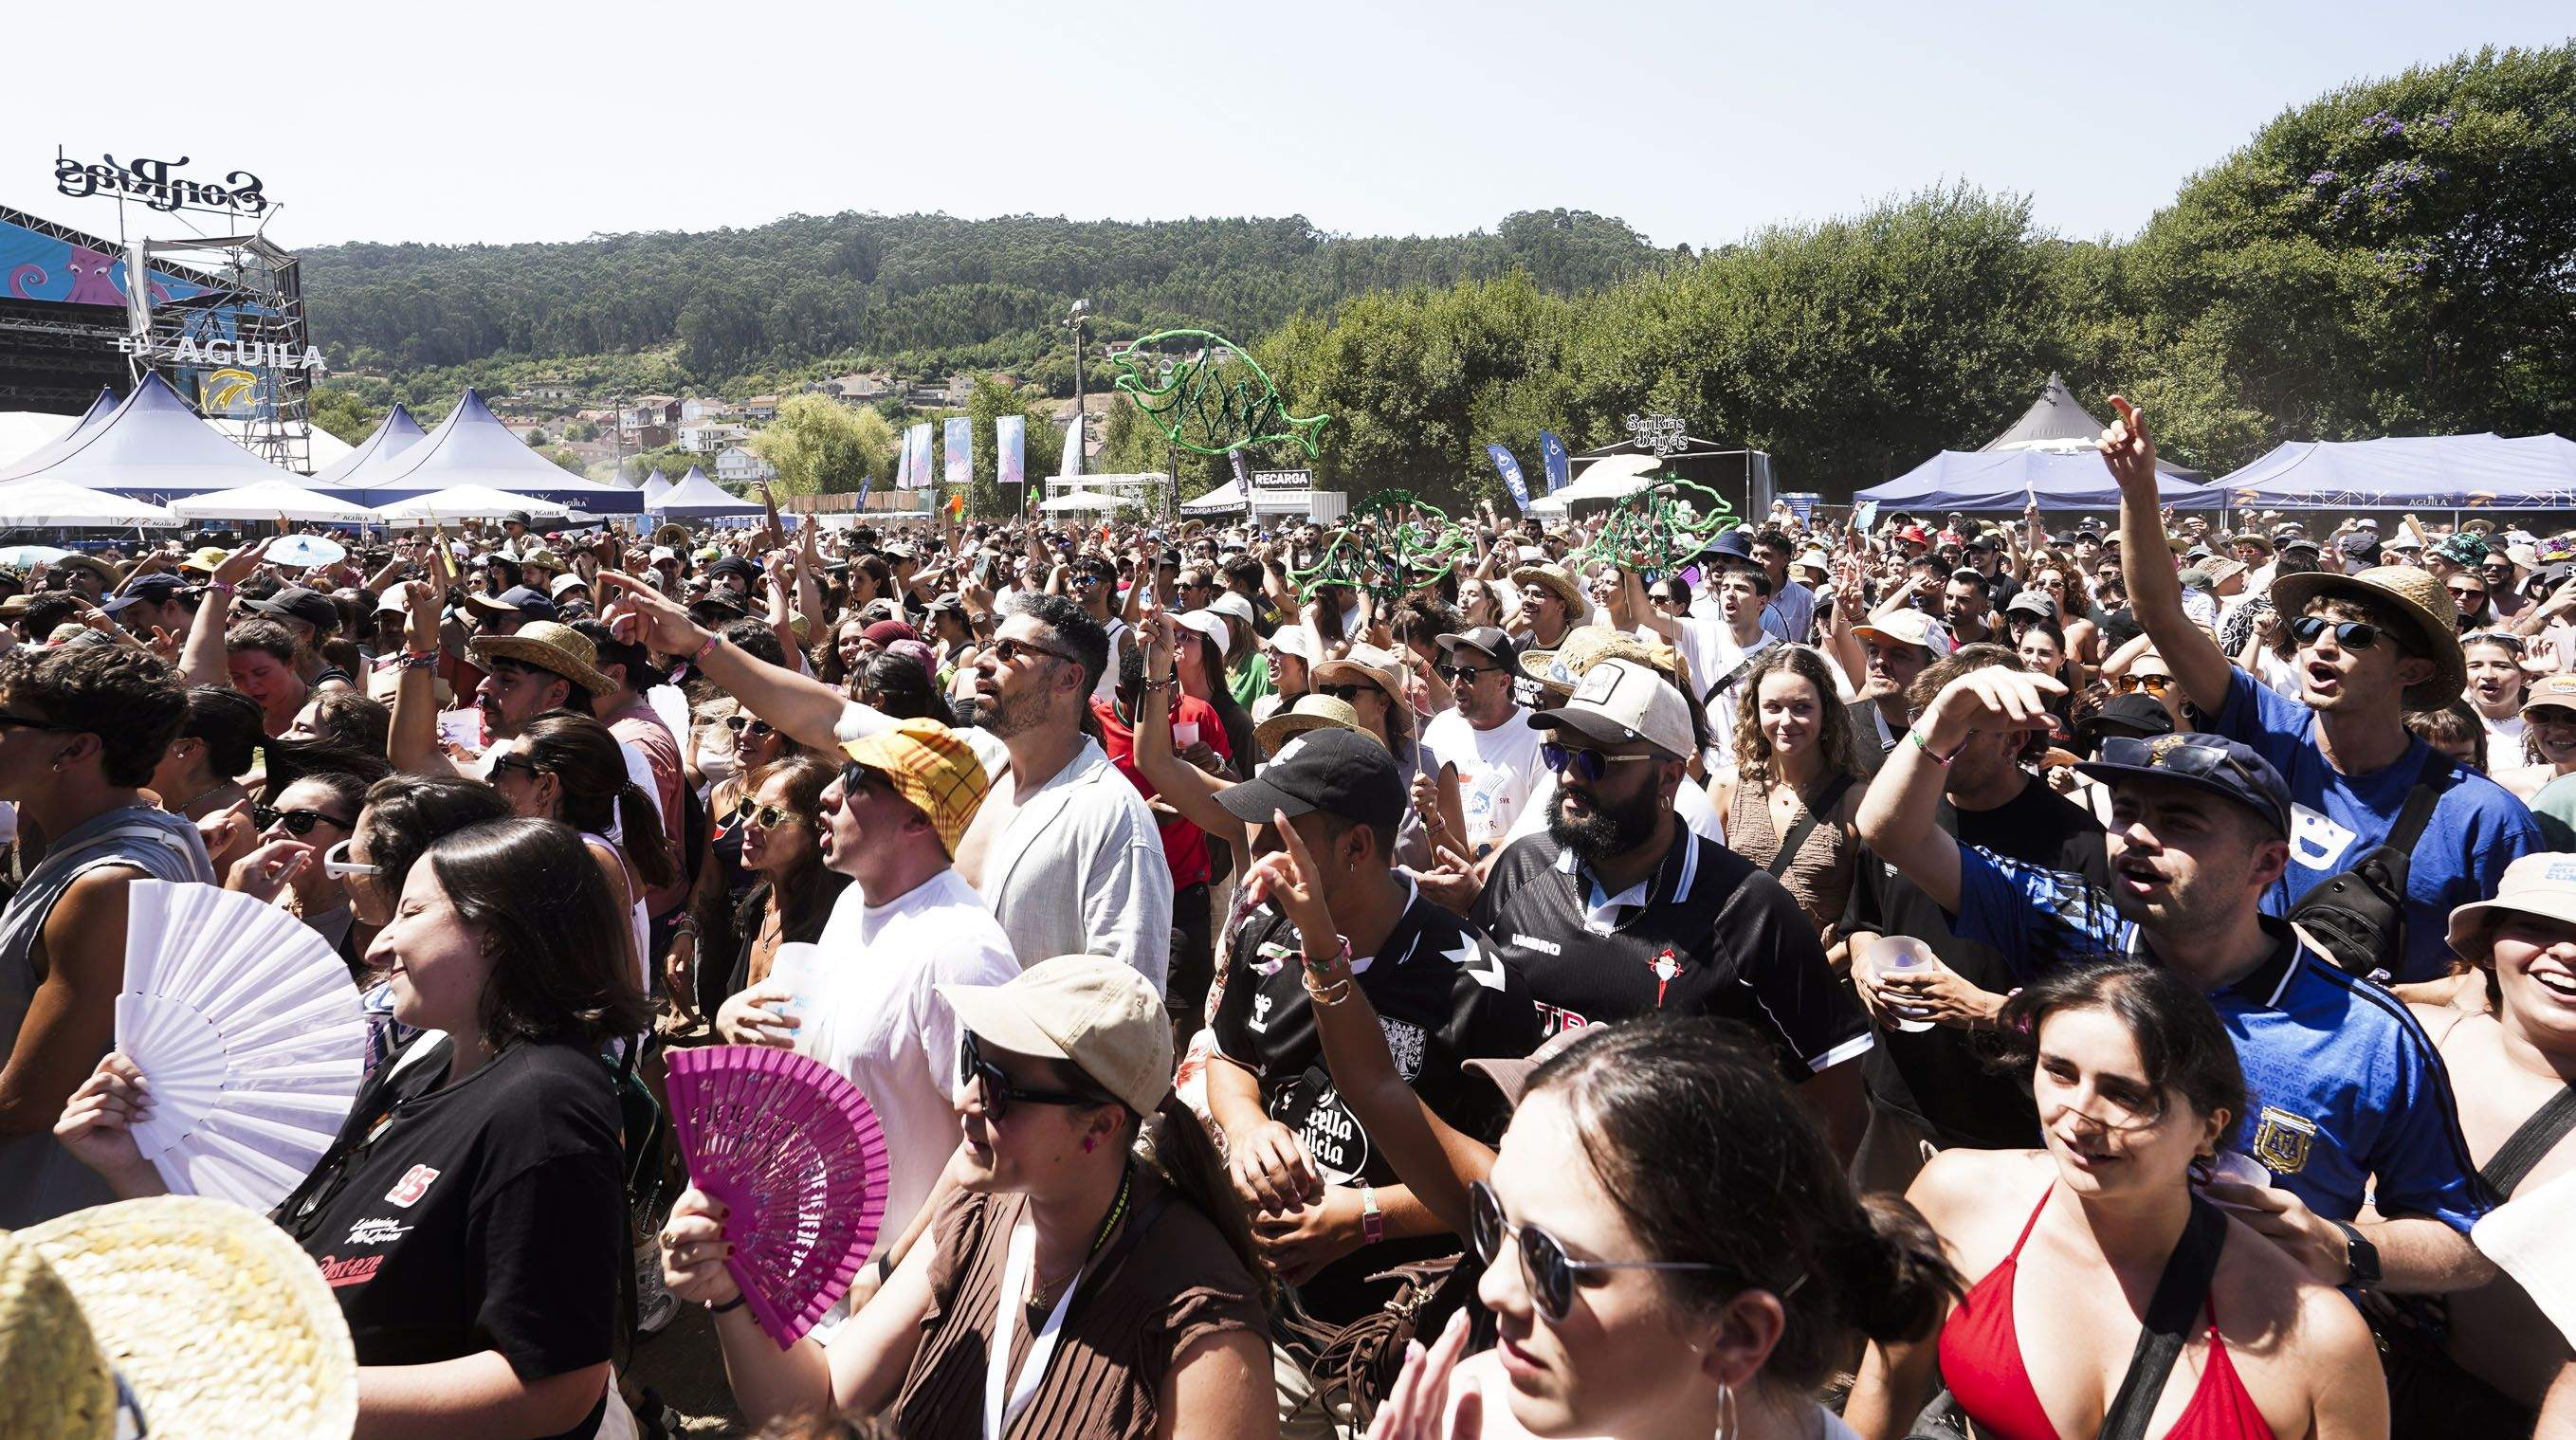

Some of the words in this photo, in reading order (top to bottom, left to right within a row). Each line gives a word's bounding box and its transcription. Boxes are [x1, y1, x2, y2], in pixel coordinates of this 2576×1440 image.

[1255, 473, 1307, 485] RECARGA
[1506, 467, 1527, 497] PMR
[1179, 506, 1212, 515] RECARGA
[1512, 934, 1561, 956] UMBRO
[384, 1164, 441, 1208] 95
